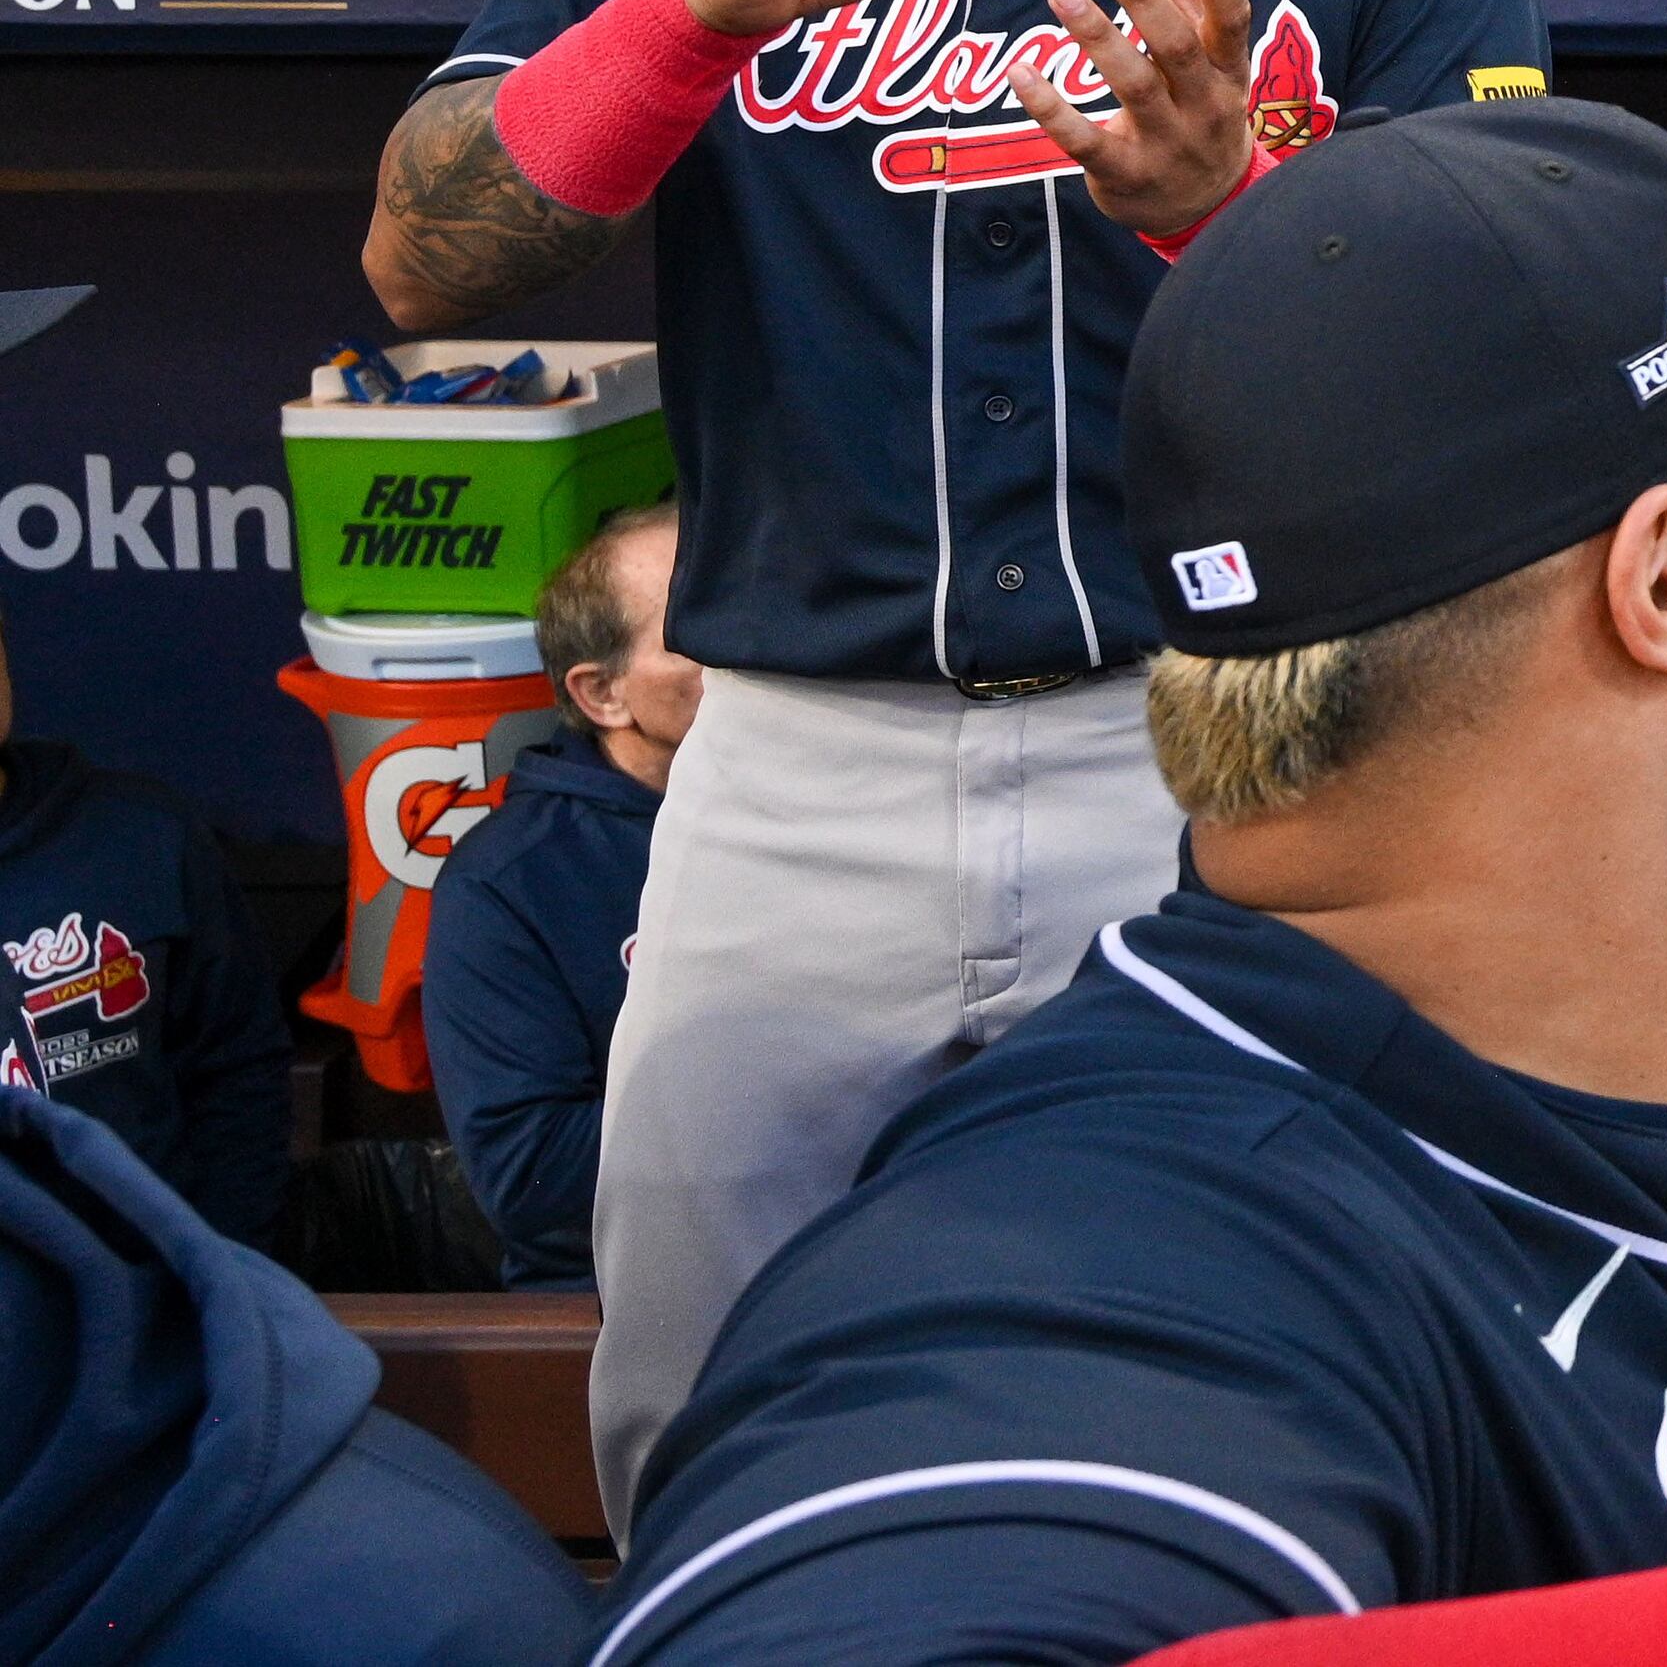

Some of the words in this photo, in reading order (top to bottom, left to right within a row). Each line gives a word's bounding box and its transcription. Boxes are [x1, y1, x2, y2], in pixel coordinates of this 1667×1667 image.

[0, 451, 293, 571] okin
[362, 475, 472, 518] FAST
[338, 525, 504, 568] TWITCH
[46, 1034, 139, 1076] TSEASON
